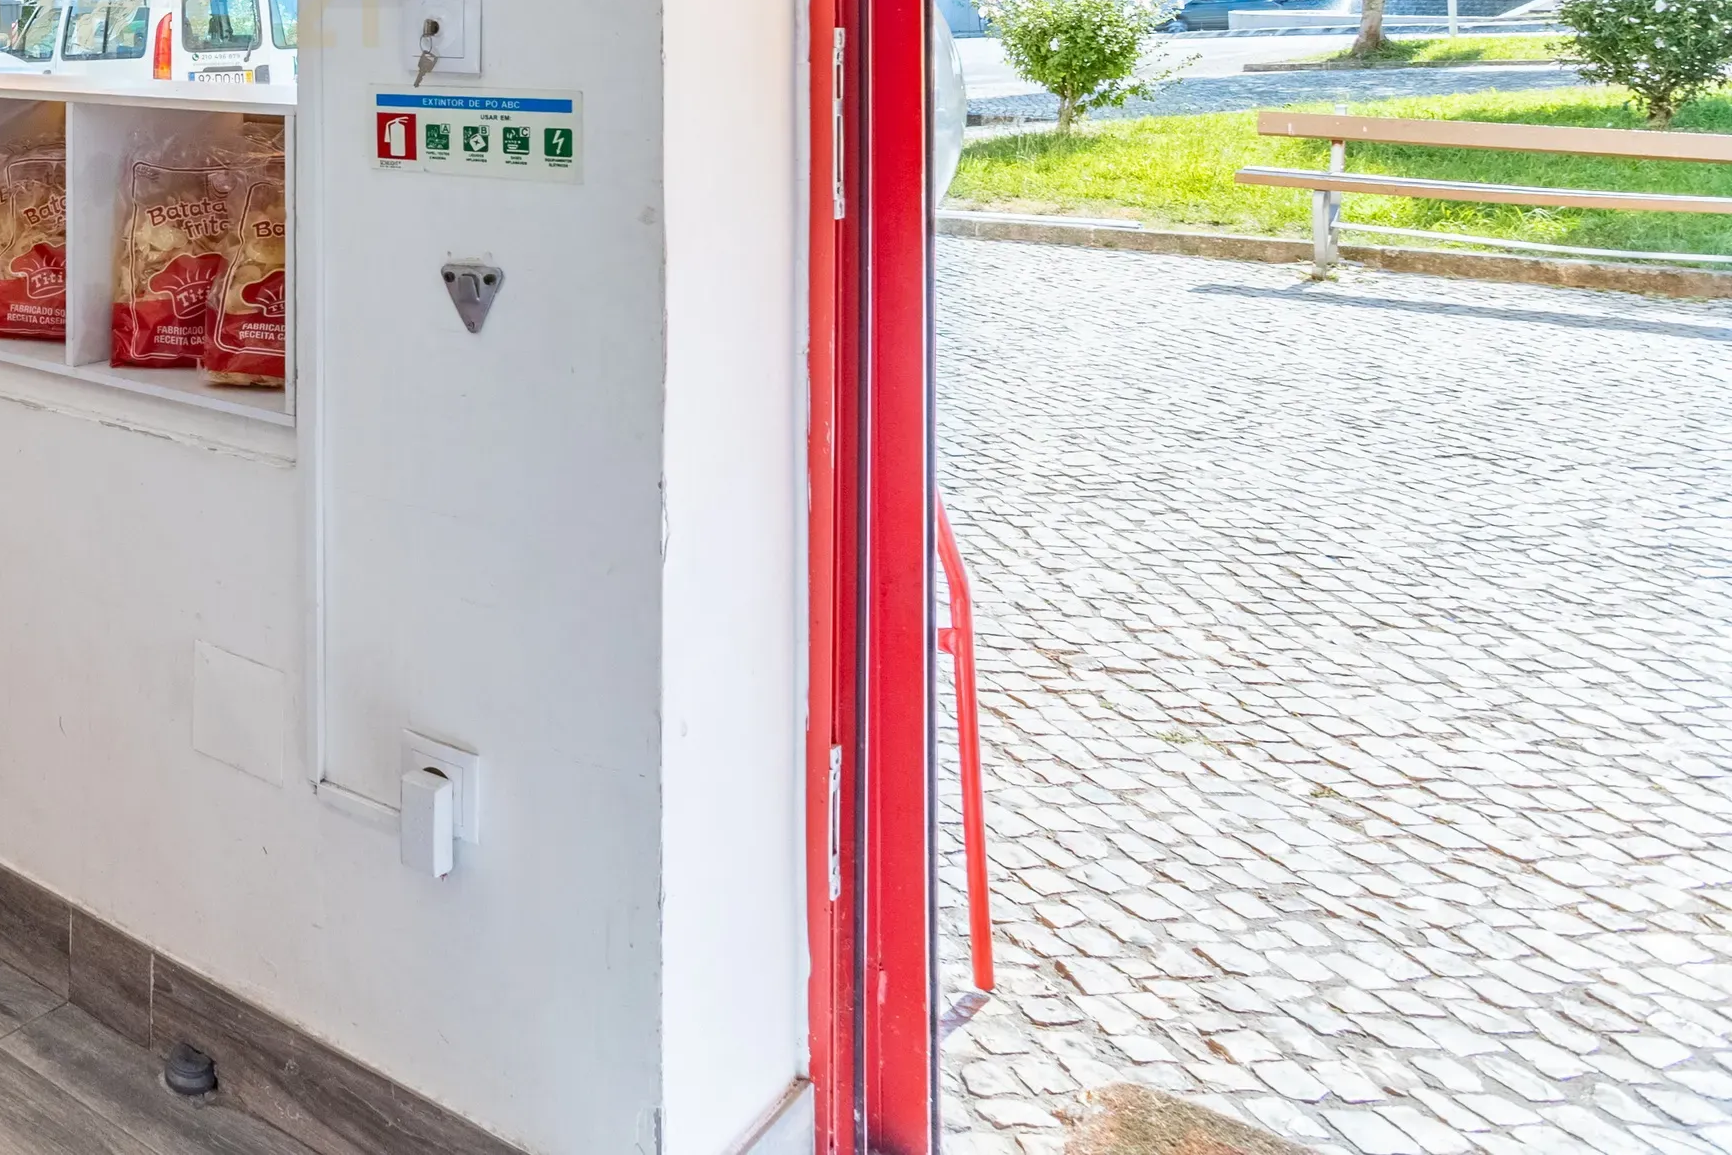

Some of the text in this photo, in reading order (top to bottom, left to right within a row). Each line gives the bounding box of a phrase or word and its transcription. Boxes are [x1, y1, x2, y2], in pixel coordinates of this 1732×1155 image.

[422, 97, 464, 107] EXTINTOR
[468, 99, 481, 108] DE
[501, 101, 521, 109] ABC
[441, 125, 449, 133] A
[480, 126, 488, 134] B
[520, 127, 529, 136] C
[146, 198, 227, 227] Batata
[10, 304, 53, 316] FABRICADO
[7, 313, 38, 323] RECEITA
[157, 326, 204, 335] FABRICADO
[153, 335, 189, 345] RECEITA
[239, 331, 275, 340] RECEITA
